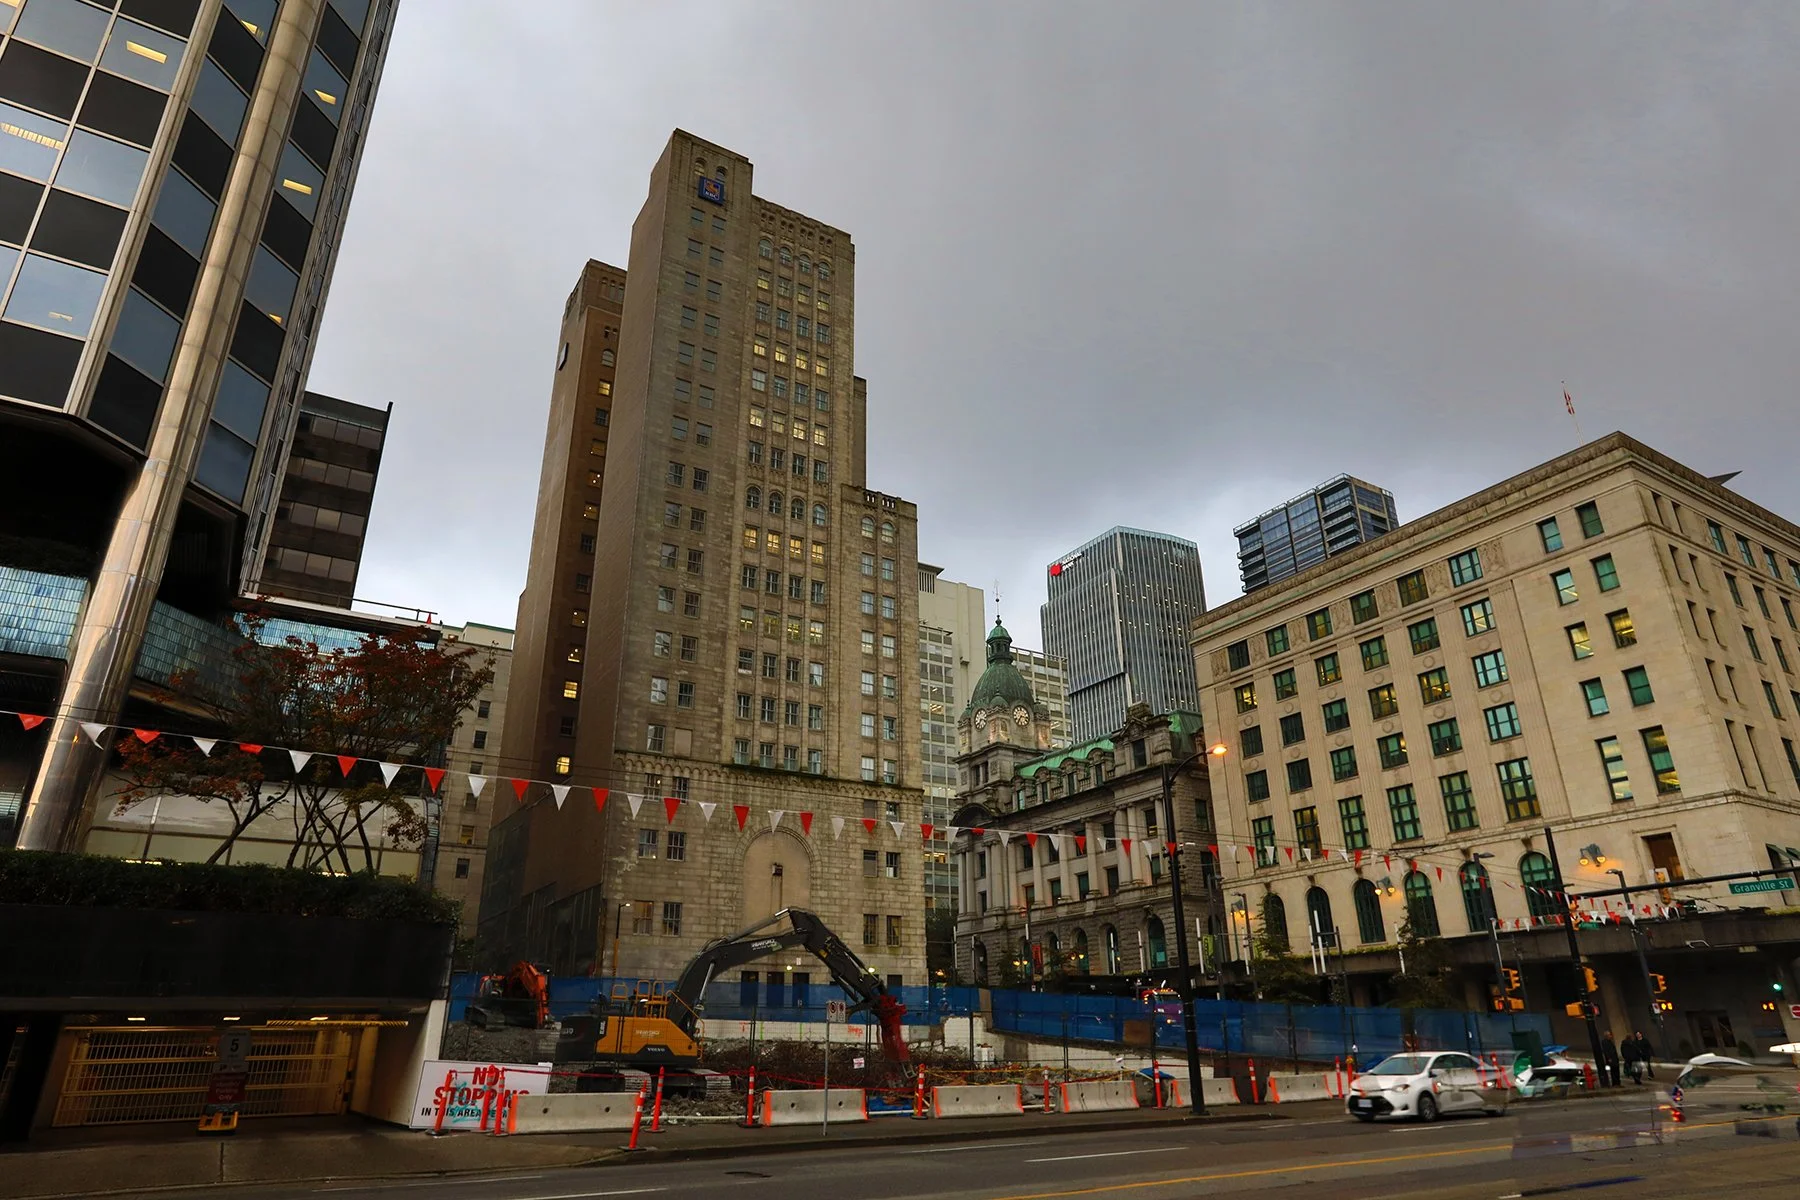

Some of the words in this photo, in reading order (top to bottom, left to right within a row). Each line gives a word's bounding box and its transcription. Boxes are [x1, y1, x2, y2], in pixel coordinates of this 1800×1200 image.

[1734, 882, 1776, 893] Granville
[1779, 880, 1789, 888] St
[230, 1038, 239, 1053] 5
[421, 1107, 432, 1116] IN
[434, 1107, 455, 1117] TIS
[457, 1109, 482, 1118] AREA
